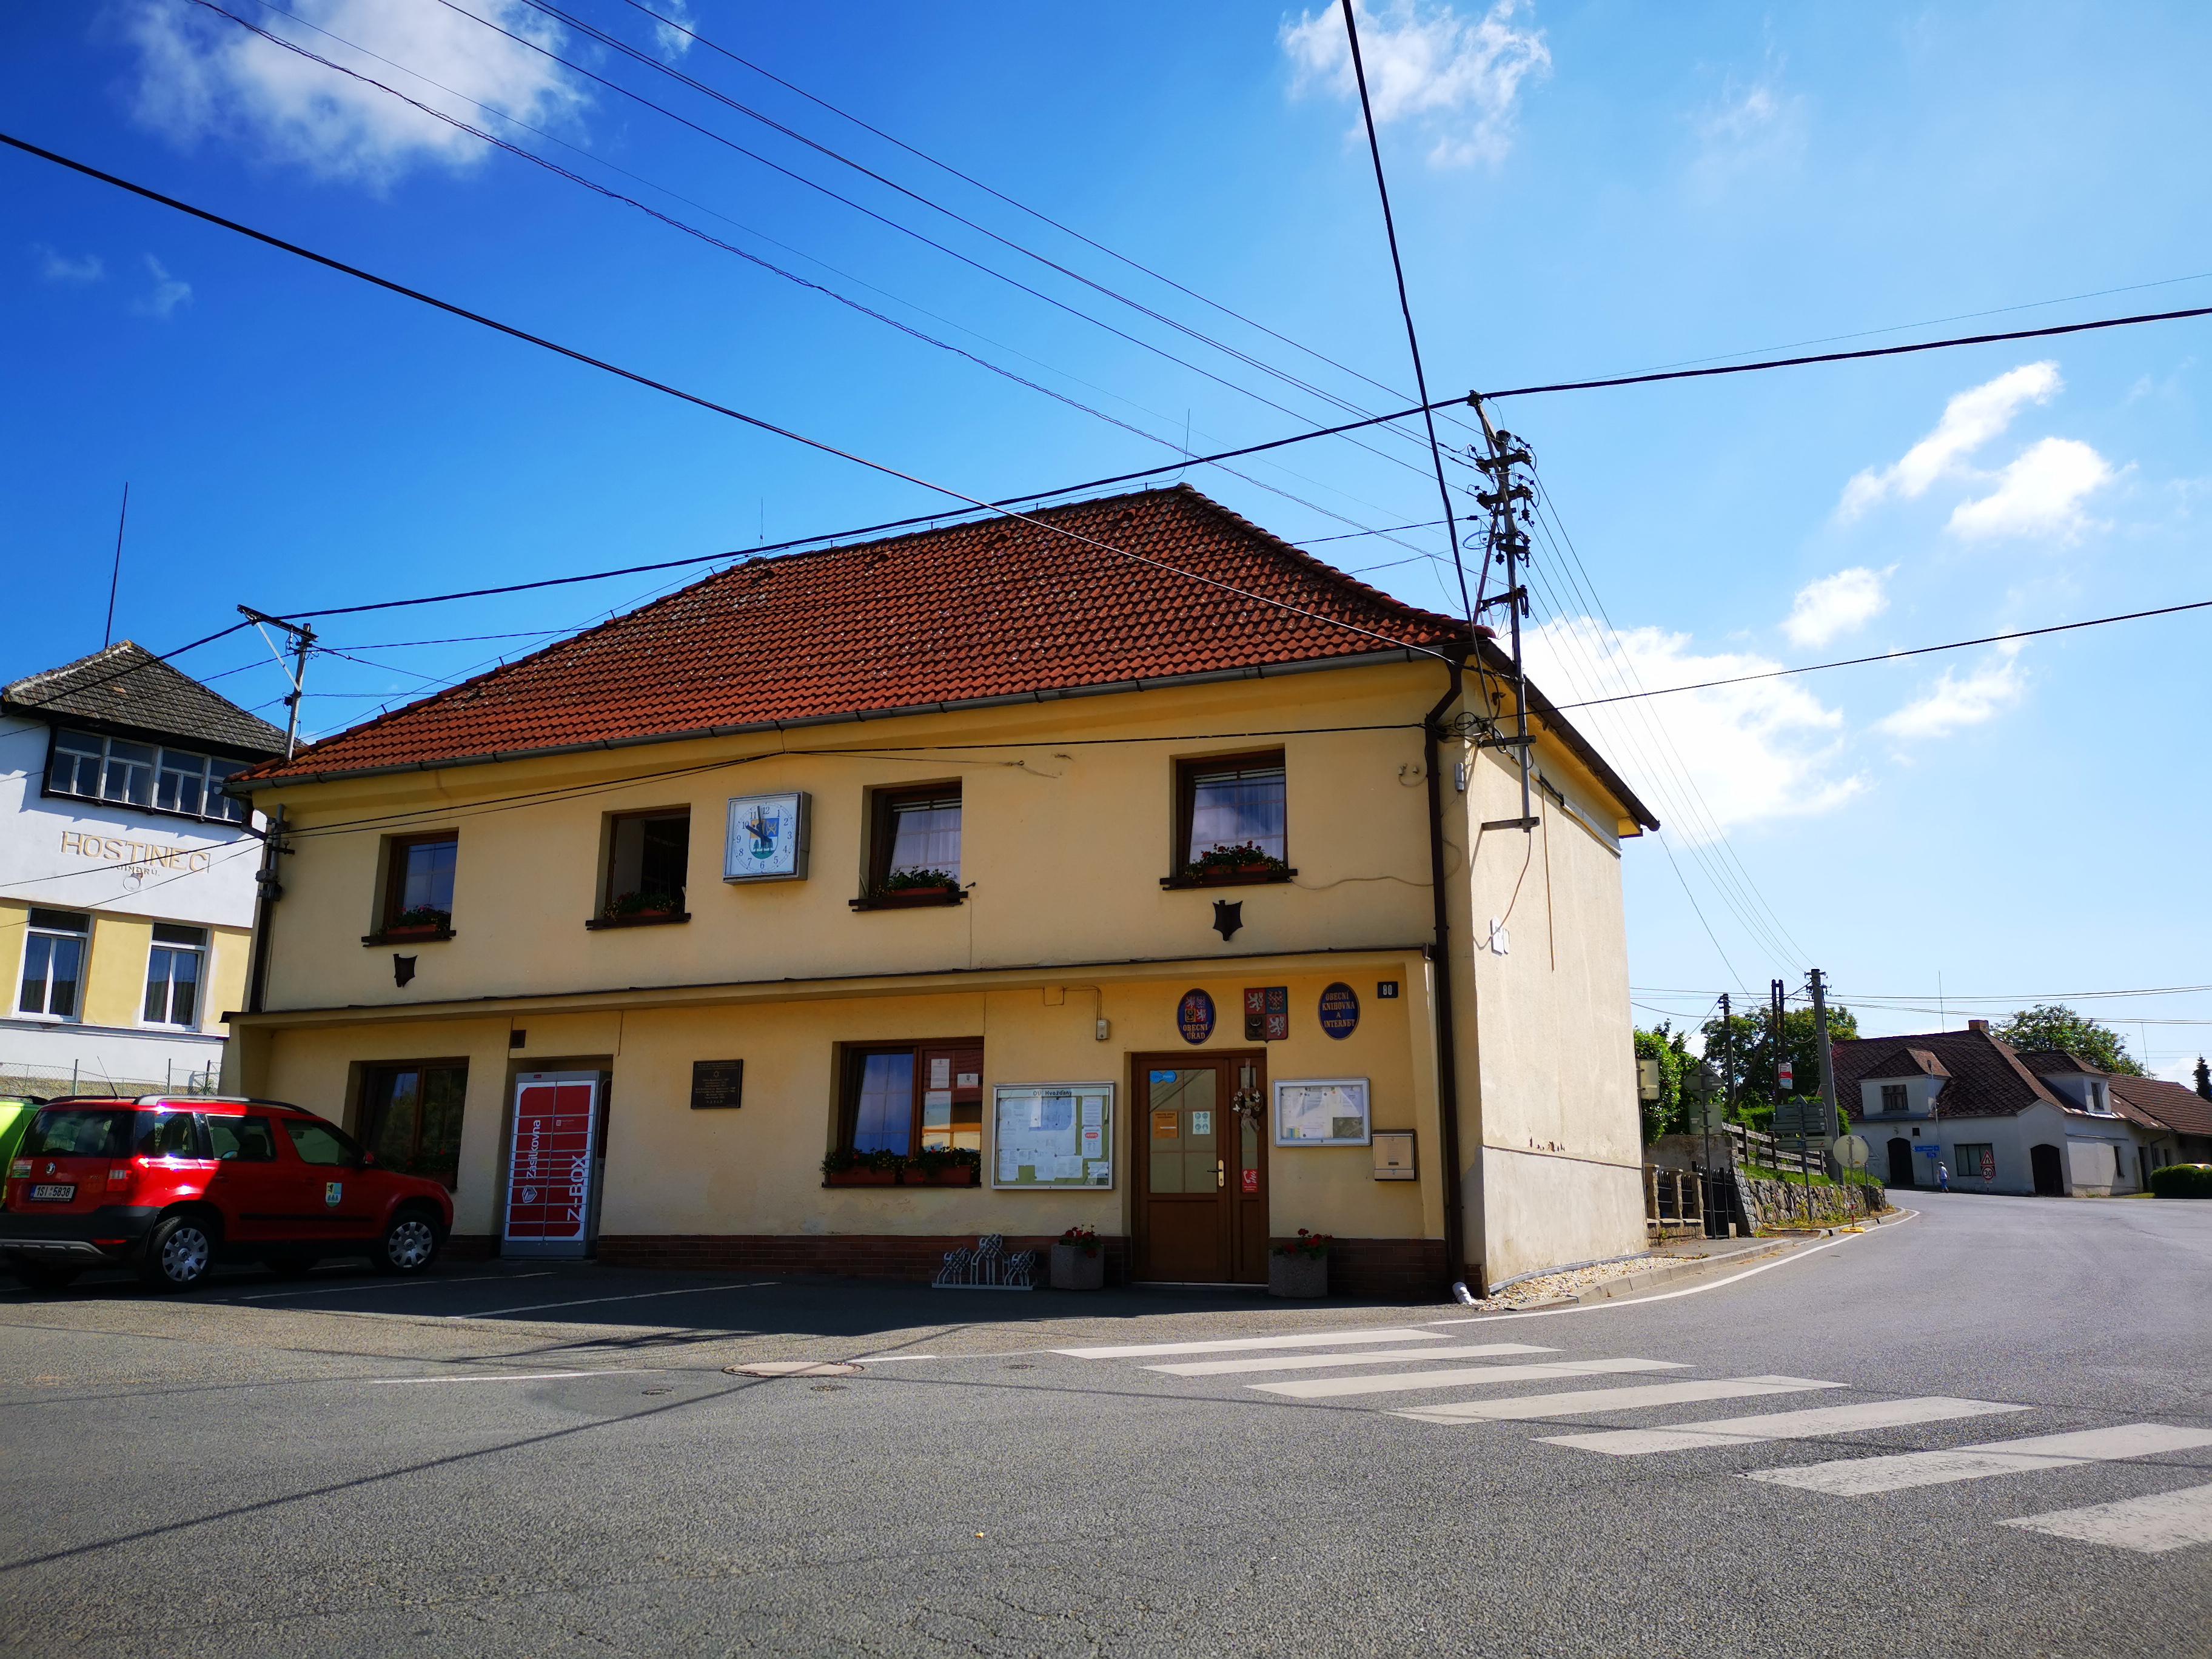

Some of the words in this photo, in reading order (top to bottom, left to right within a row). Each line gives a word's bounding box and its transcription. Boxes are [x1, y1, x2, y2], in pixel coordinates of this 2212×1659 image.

[762, 806, 770, 815] 12
[783, 817, 789, 826] 2
[62, 831, 209, 874] HOSTINEC
[1326, 989, 1350, 1000] OBECNÍ
[1382, 985, 1392, 996] 80
[1322, 1002, 1355, 1011] KNIHOVNA
[1183, 1022, 1209, 1031] OBECNÍ
[1324, 1019, 1355, 1028] INTERNET
[526, 1119, 541, 1180] Zásilkovna
[53, 1187, 71, 1197] 5838
[567, 1155, 588, 1222] Z-BOX
